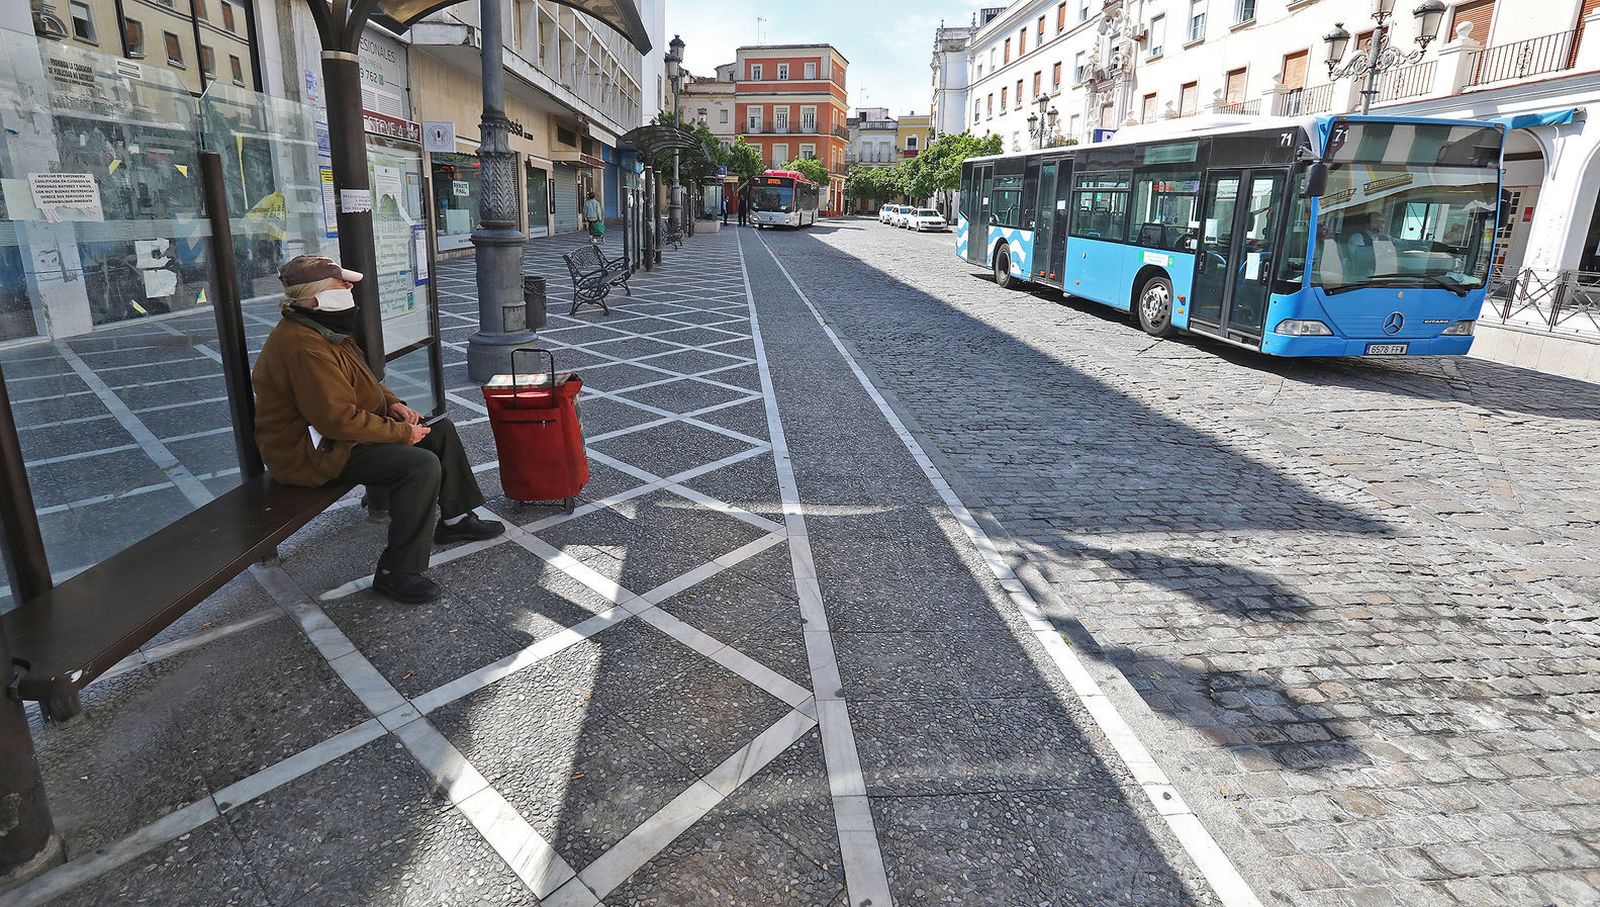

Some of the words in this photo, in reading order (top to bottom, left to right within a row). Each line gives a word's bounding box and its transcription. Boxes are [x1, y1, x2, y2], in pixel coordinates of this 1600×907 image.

[1280, 132, 1292, 146] 71
[1335, 129, 1349, 142] 71
[1371, 345, 1390, 354] 6578
